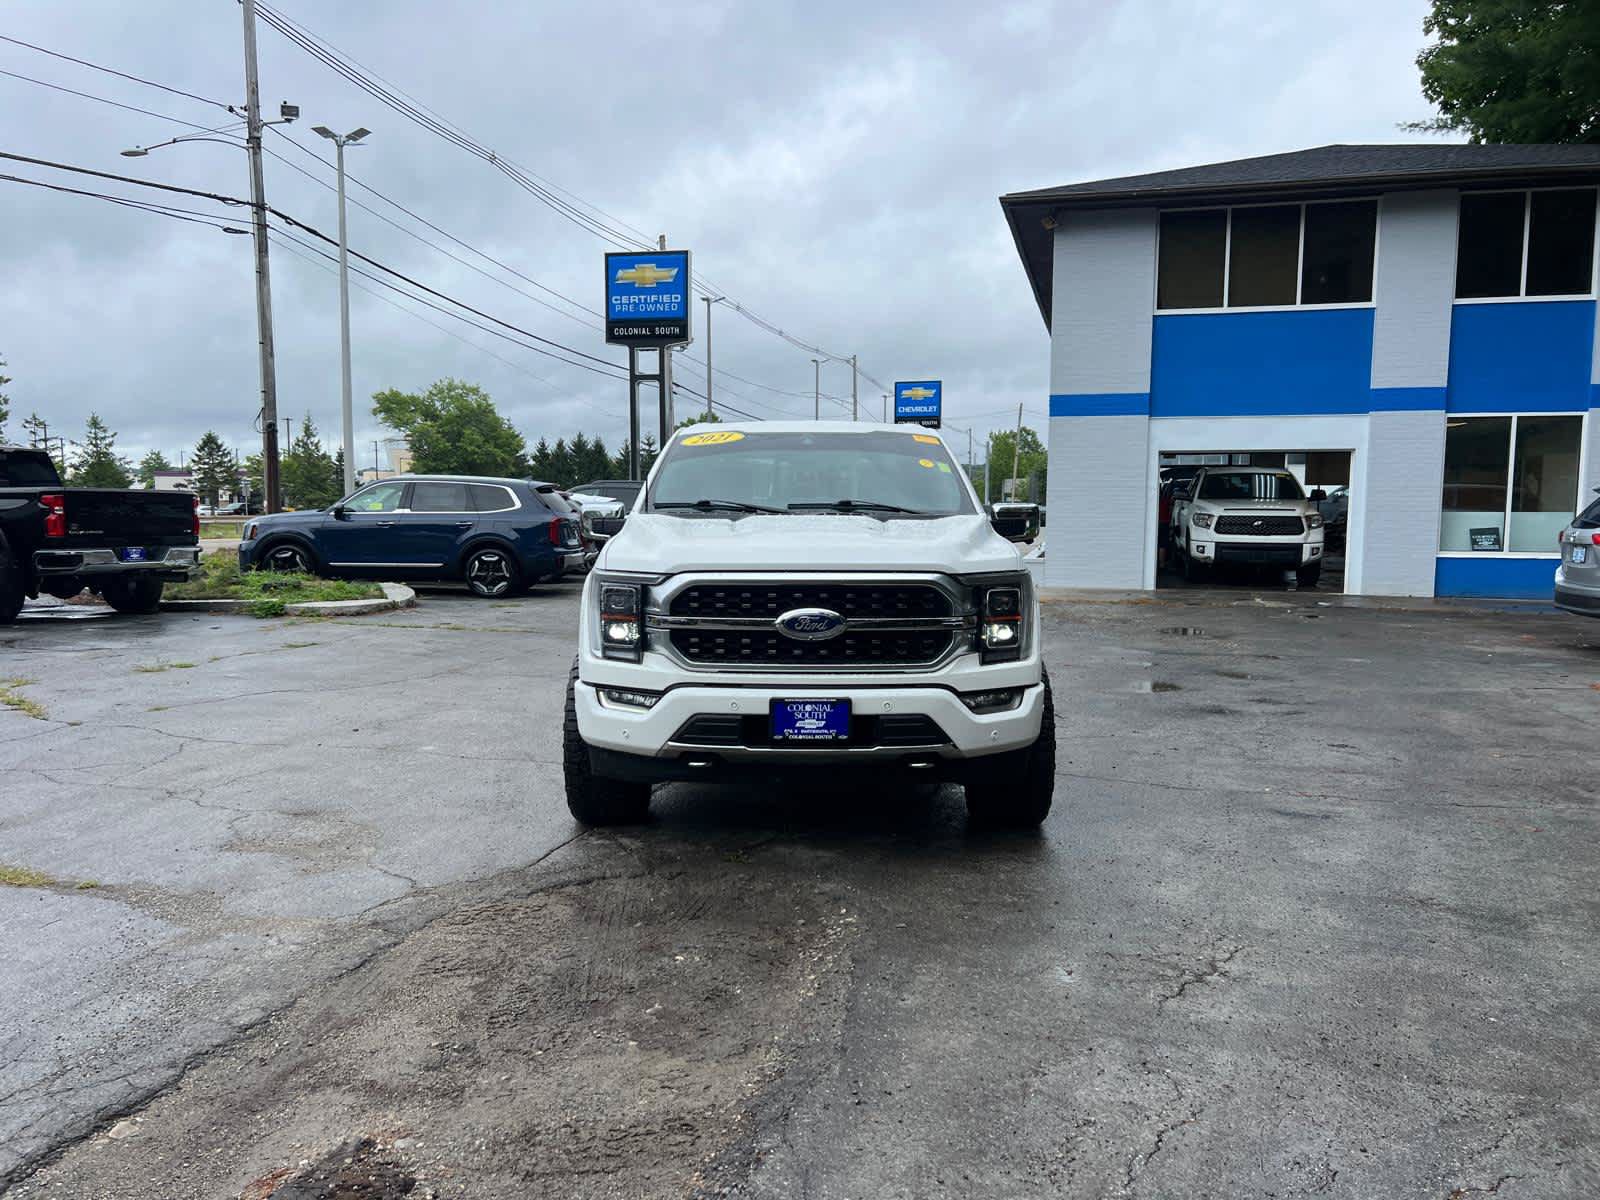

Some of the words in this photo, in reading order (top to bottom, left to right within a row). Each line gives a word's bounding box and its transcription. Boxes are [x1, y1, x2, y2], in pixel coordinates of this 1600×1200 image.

[611, 294, 681, 304] CERTIFIED
[615, 304, 635, 312] PRE
[640, 303, 678, 312] OWNED
[614, 327, 650, 336] COLONIAL
[655, 327, 680, 335] SOUTH
[795, 615, 828, 631] Ford
[787, 703, 834, 712] COLONIAL
[794, 711, 827, 720] SOUTH
